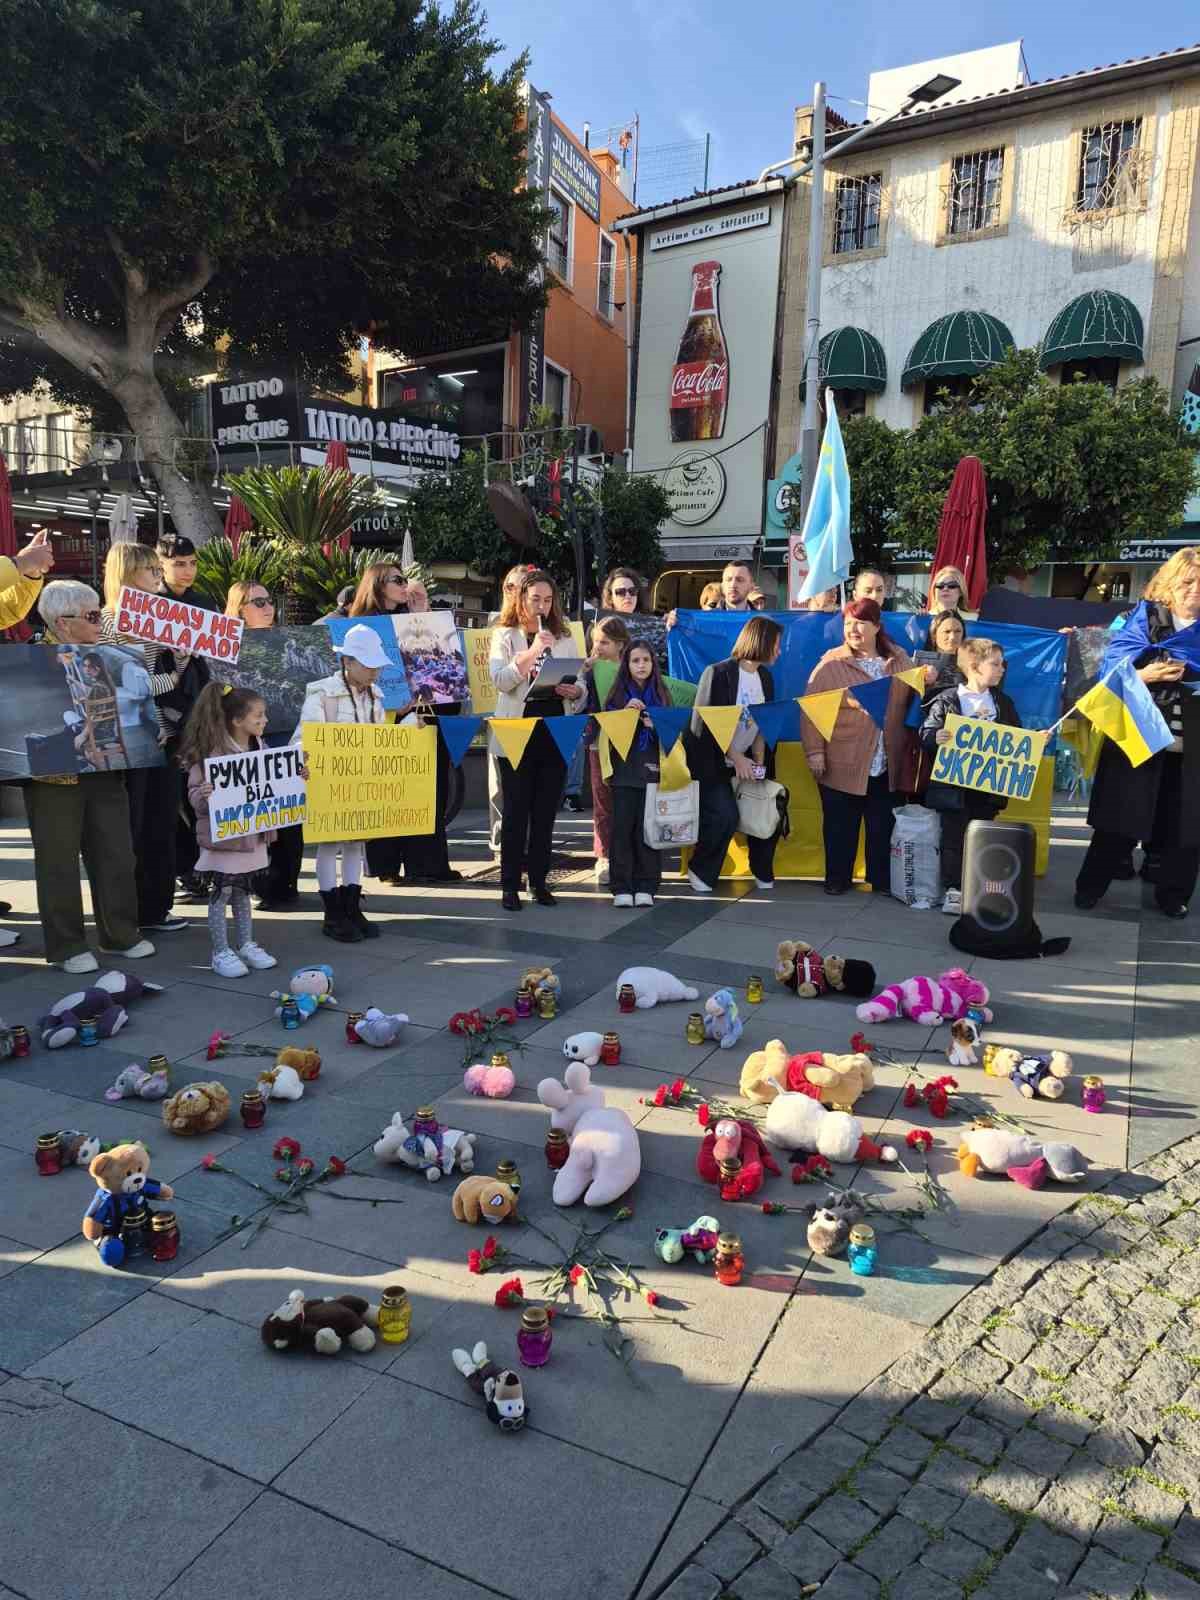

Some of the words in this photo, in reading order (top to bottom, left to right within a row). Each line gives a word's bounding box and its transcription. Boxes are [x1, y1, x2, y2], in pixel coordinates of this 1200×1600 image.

[220, 377, 284, 405] TATTOO
[245, 403, 260, 421] &
[217, 418, 289, 446] PIERCING
[304, 407, 374, 442] TATTOO
[375, 421, 389, 448] &
[211, 615, 241, 640] НЕ
[315, 728, 325, 748] 4
[333, 727, 364, 749] РОКИ
[956, 723, 1032, 761] СЛАВА
[209, 756, 260, 790] РУКИ
[264, 749, 304, 781] ГЕТЬ
[315, 754, 325, 776] 4
[332, 755, 363, 777] РОКИ
[329, 783, 352, 802] МИ
